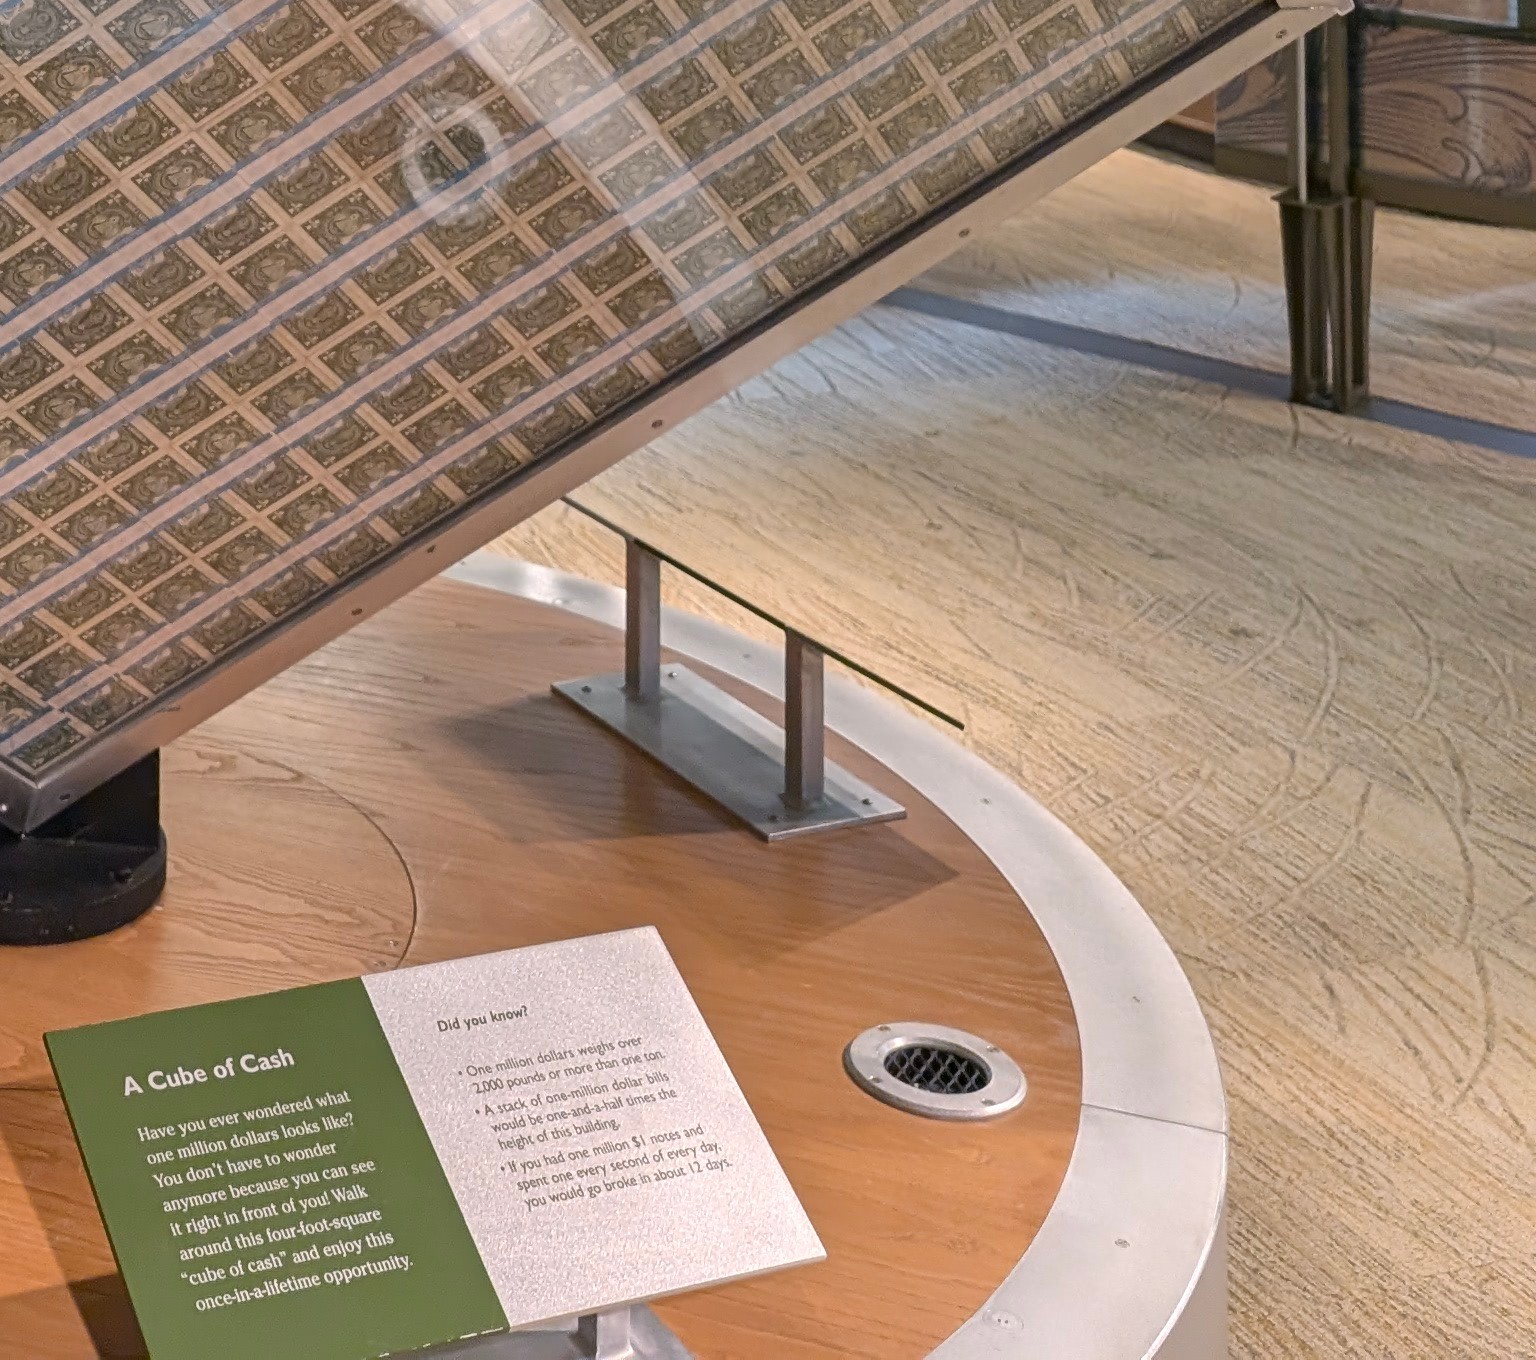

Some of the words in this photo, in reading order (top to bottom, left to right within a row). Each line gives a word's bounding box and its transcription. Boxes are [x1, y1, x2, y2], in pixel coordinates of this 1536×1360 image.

[436, 1016, 461, 1033] Did
[462, 1015, 488, 1032] you
[489, 1004, 528, 1023] know?
[124, 1075, 144, 1097] A
[147, 1066, 209, 1091] Cube
[213, 1057, 236, 1079] of
[239, 1048, 295, 1074] Cash
[465, 1064, 493, 1077] One
[495, 1057, 535, 1072] million
[536, 1049, 575, 1064] dollars
[577, 1040, 616, 1056] weighs
[617, 1037, 642, 1049] over
[471, 1077, 505, 1095] 2,000
[506, 1070, 546, 1091] pounds
[548, 1069, 561, 1080] or
[563, 1063, 594, 1077] more
[594, 1058, 620, 1071] than
[621, 1054, 643, 1066] one
[643, 1051, 666, 1062] ton.
[136, 1125, 176, 1142] Have
[177, 1119, 207, 1138] you
[208, 1112, 240, 1128] ever
[242, 1095, 314, 1121] wondered
[314, 1090, 352, 1108] what
[484, 1103, 496, 1117] A
[497, 1098, 529, 1114] stack
[530, 1093, 543, 1107] of
[545, 1084, 610, 1104] one-million
[611, 1077, 643, 1091] dollar
[644, 1071, 670, 1085] bills
[490, 1114, 527, 1133] would
[527, 1114, 544, 1126] be
[545, 1096, 624, 1122] one-and-a-half
[625, 1093, 657, 1107] times
[657, 1088, 678, 1101] the
[146, 1150, 175, 1165] one
[176, 1140, 228, 1159] million
[229, 1129, 280, 1149] dollars
[280, 1120, 321, 1139] looks
[321, 1112, 354, 1131] like?
[497, 1134, 536, 1151] height
[536, 1128, 549, 1143] of
[550, 1127, 573, 1140] this
[572, 1119, 621, 1136] building.
[507, 1160, 518, 1173] If
[519, 1159, 542, 1175] you
[542, 1150, 566, 1166] had
[567, 1149, 591, 1161] one
[592, 1140, 631, 1157] million
[631, 1134, 647, 1149] $1
[649, 1131, 682, 1145] notes
[683, 1123, 705, 1139] and
[151, 1172, 184, 1188] You
[185, 1162, 225, 1182] don't
[225, 1157, 263, 1174] have
[264, 1153, 281, 1167] to
[282, 1142, 337, 1163] wonder
[162, 1189, 228, 1213] anymore
[227, 1177, 290, 1199] because
[290, 1171, 320, 1190] you
[322, 1166, 349, 1180] can
[350, 1160, 376, 1175] see
[516, 1176, 550, 1193] spent
[551, 1171, 574, 1184] one
[576, 1164, 607, 1179] every
[609, 1152, 651, 1172] second
[652, 1148, 665, 1163] of
[666, 1146, 697, 1160] every
[699, 1140, 722, 1155] day,
[523, 1196, 547, 1213] you
[547, 1184, 585, 1203] would
[586, 1185, 602, 1199] go
[602, 1176, 638, 1192] broke
[638, 1173, 652, 1185] in
[653, 1167, 687, 1182] about
[687, 1160, 704, 1174] 12
[705, 1158, 734, 1172] days.
[169, 1222, 183, 1237] it
[185, 1214, 222, 1235] right
[223, 1211, 240, 1226] in
[241, 1202, 279, 1222] front
[281, 1197, 297, 1214] of
[298, 1190, 331, 1214] you!
[330, 1184, 369, 1203] Walk
[179, 1236, 233, 1261] around
[234, 1231, 265, 1250] this
[265, 1209, 383, 1243] four-foot-square
[229, 1259, 245, 1277] of
[291, 1244, 321, 1264] and
[322, 1238, 362, 1258] enjoy
[364, 1231, 395, 1249] this
[195, 1274, 322, 1312] once-in-a-lifetime
[323, 1255, 414, 1286] opportunity.
